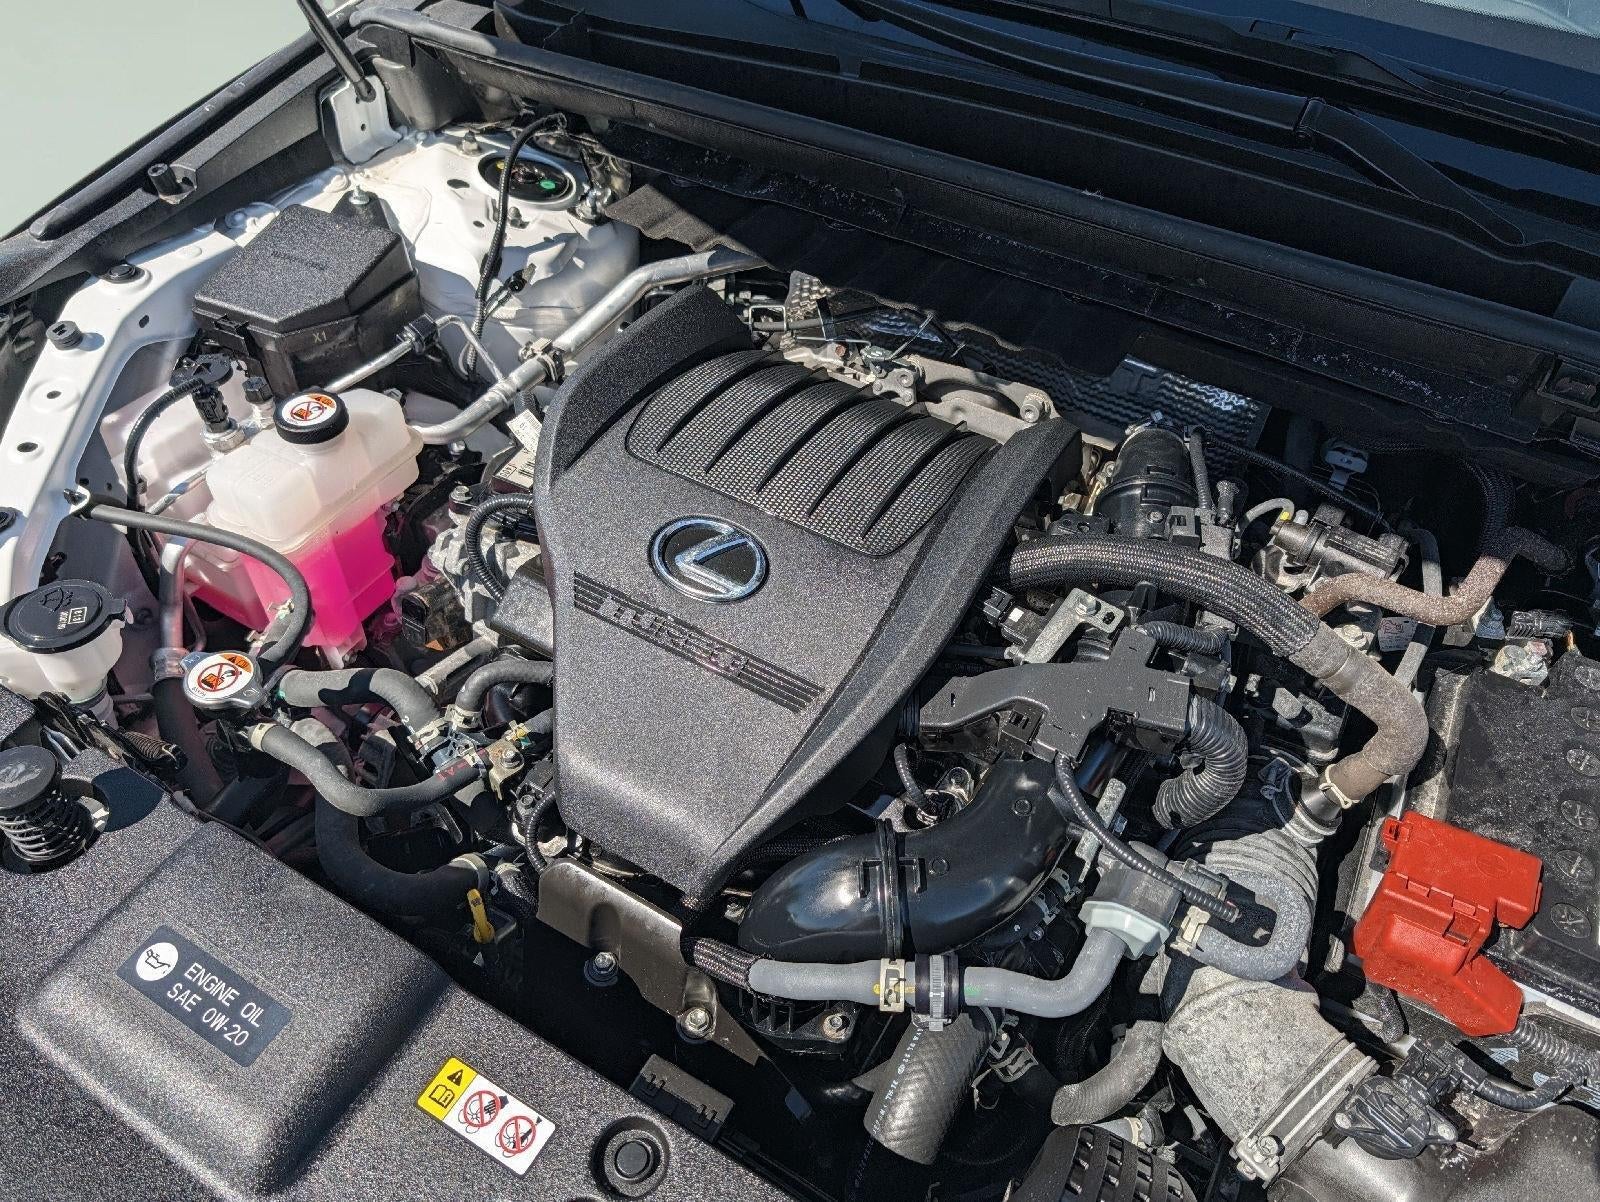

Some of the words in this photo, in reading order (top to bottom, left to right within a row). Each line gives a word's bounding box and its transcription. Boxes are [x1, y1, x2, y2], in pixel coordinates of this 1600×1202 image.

[168, 983, 202, 1012] SAE
[185, 963, 240, 1006] ENGINE
[240, 1002, 264, 1027] OIL
